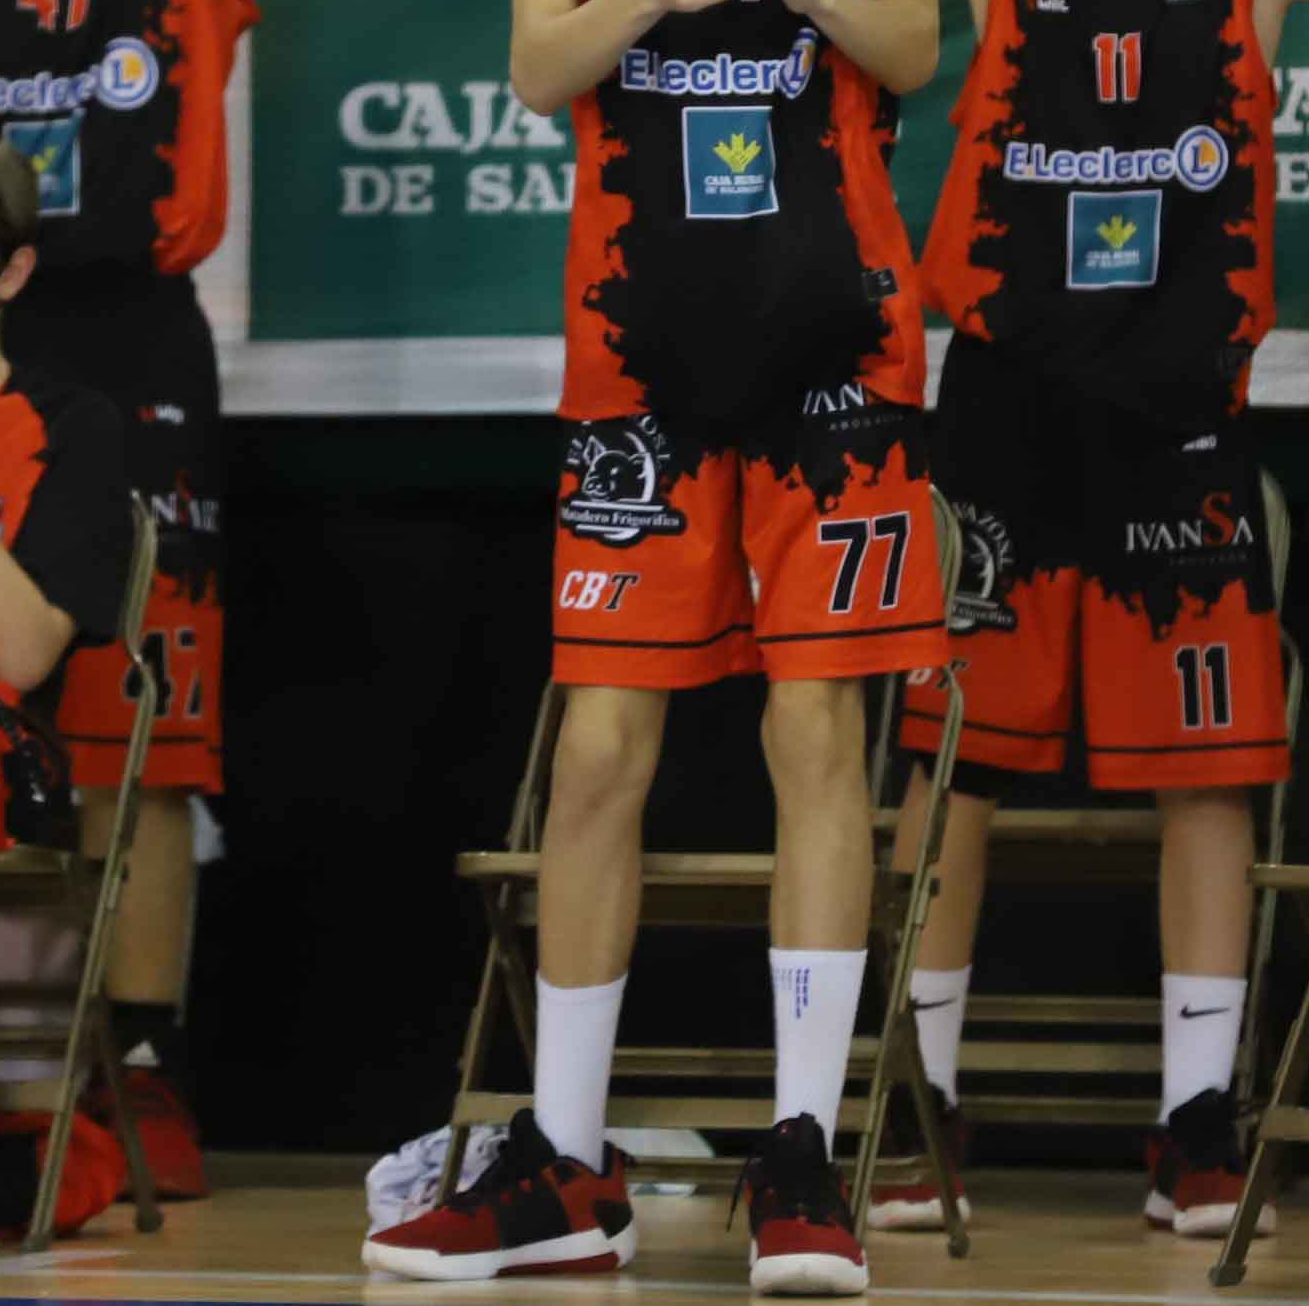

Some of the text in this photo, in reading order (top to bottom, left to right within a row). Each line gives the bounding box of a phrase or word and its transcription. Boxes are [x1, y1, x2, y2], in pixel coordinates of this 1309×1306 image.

[1093, 31, 1142, 103] 11
[339, 81, 567, 153] CAJA
[340, 165, 435, 215] DE
[559, 569, 640, 612] CBT
[817, 511, 912, 615] 77
[1174, 642, 1233, 730] 11
